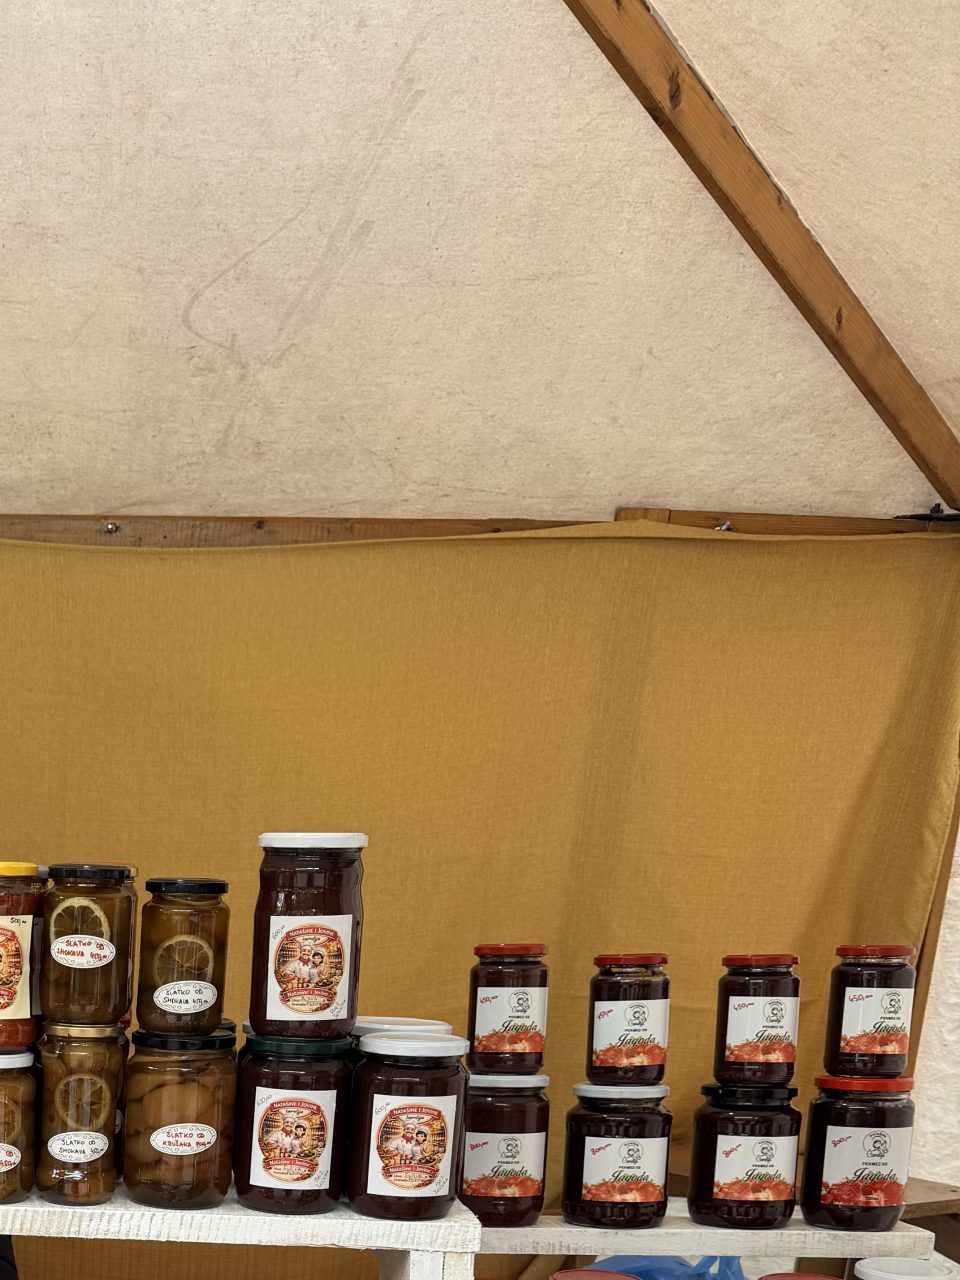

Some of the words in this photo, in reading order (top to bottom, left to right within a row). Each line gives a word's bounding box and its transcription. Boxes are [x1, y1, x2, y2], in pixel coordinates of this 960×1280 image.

[499, 1019, 538, 1034] Jagoda
[871, 1020, 906, 1035] Jagoda
[616, 1032, 656, 1047] Jagoda
[753, 1029, 791, 1044] Jagoda
[489, 1165, 528, 1178] Jagoda
[610, 1169, 649, 1183] Jagoda
[743, 1168, 782, 1182] Jagoda
[852, 1167, 896, 1183] Jagoda
